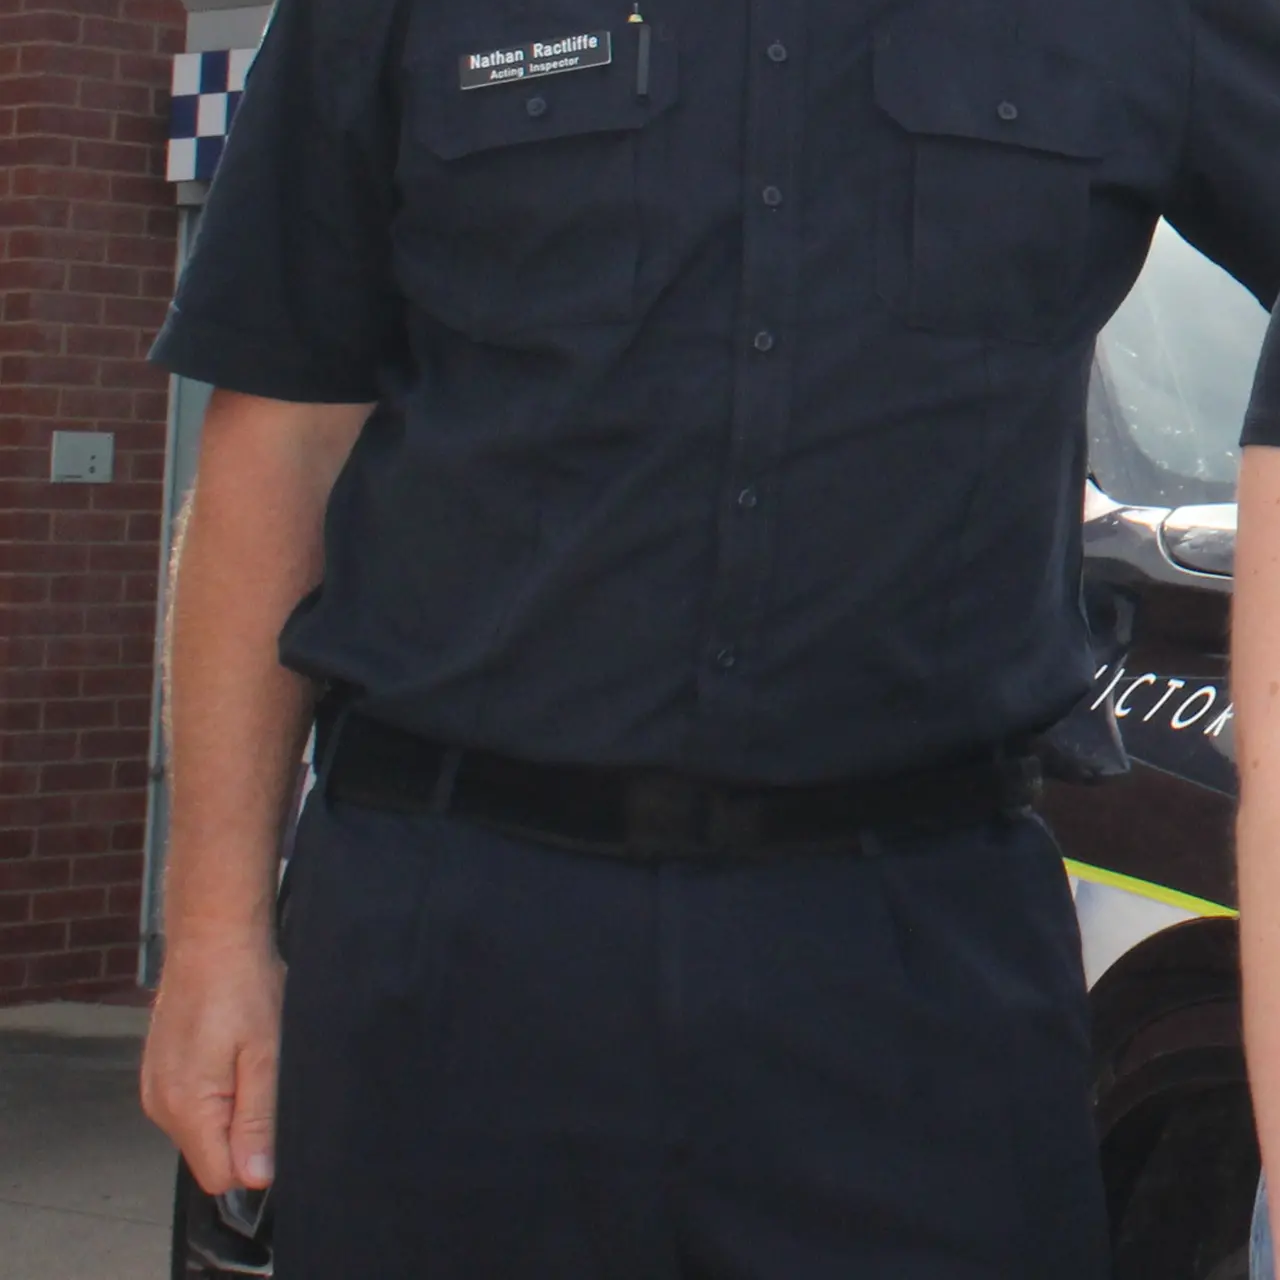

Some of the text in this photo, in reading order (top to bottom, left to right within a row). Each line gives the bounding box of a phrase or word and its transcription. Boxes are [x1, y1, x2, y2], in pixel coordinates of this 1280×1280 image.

[469, 34, 598, 70] Nathan Ractliffe
[489, 56, 580, 80] Acting Inspector
